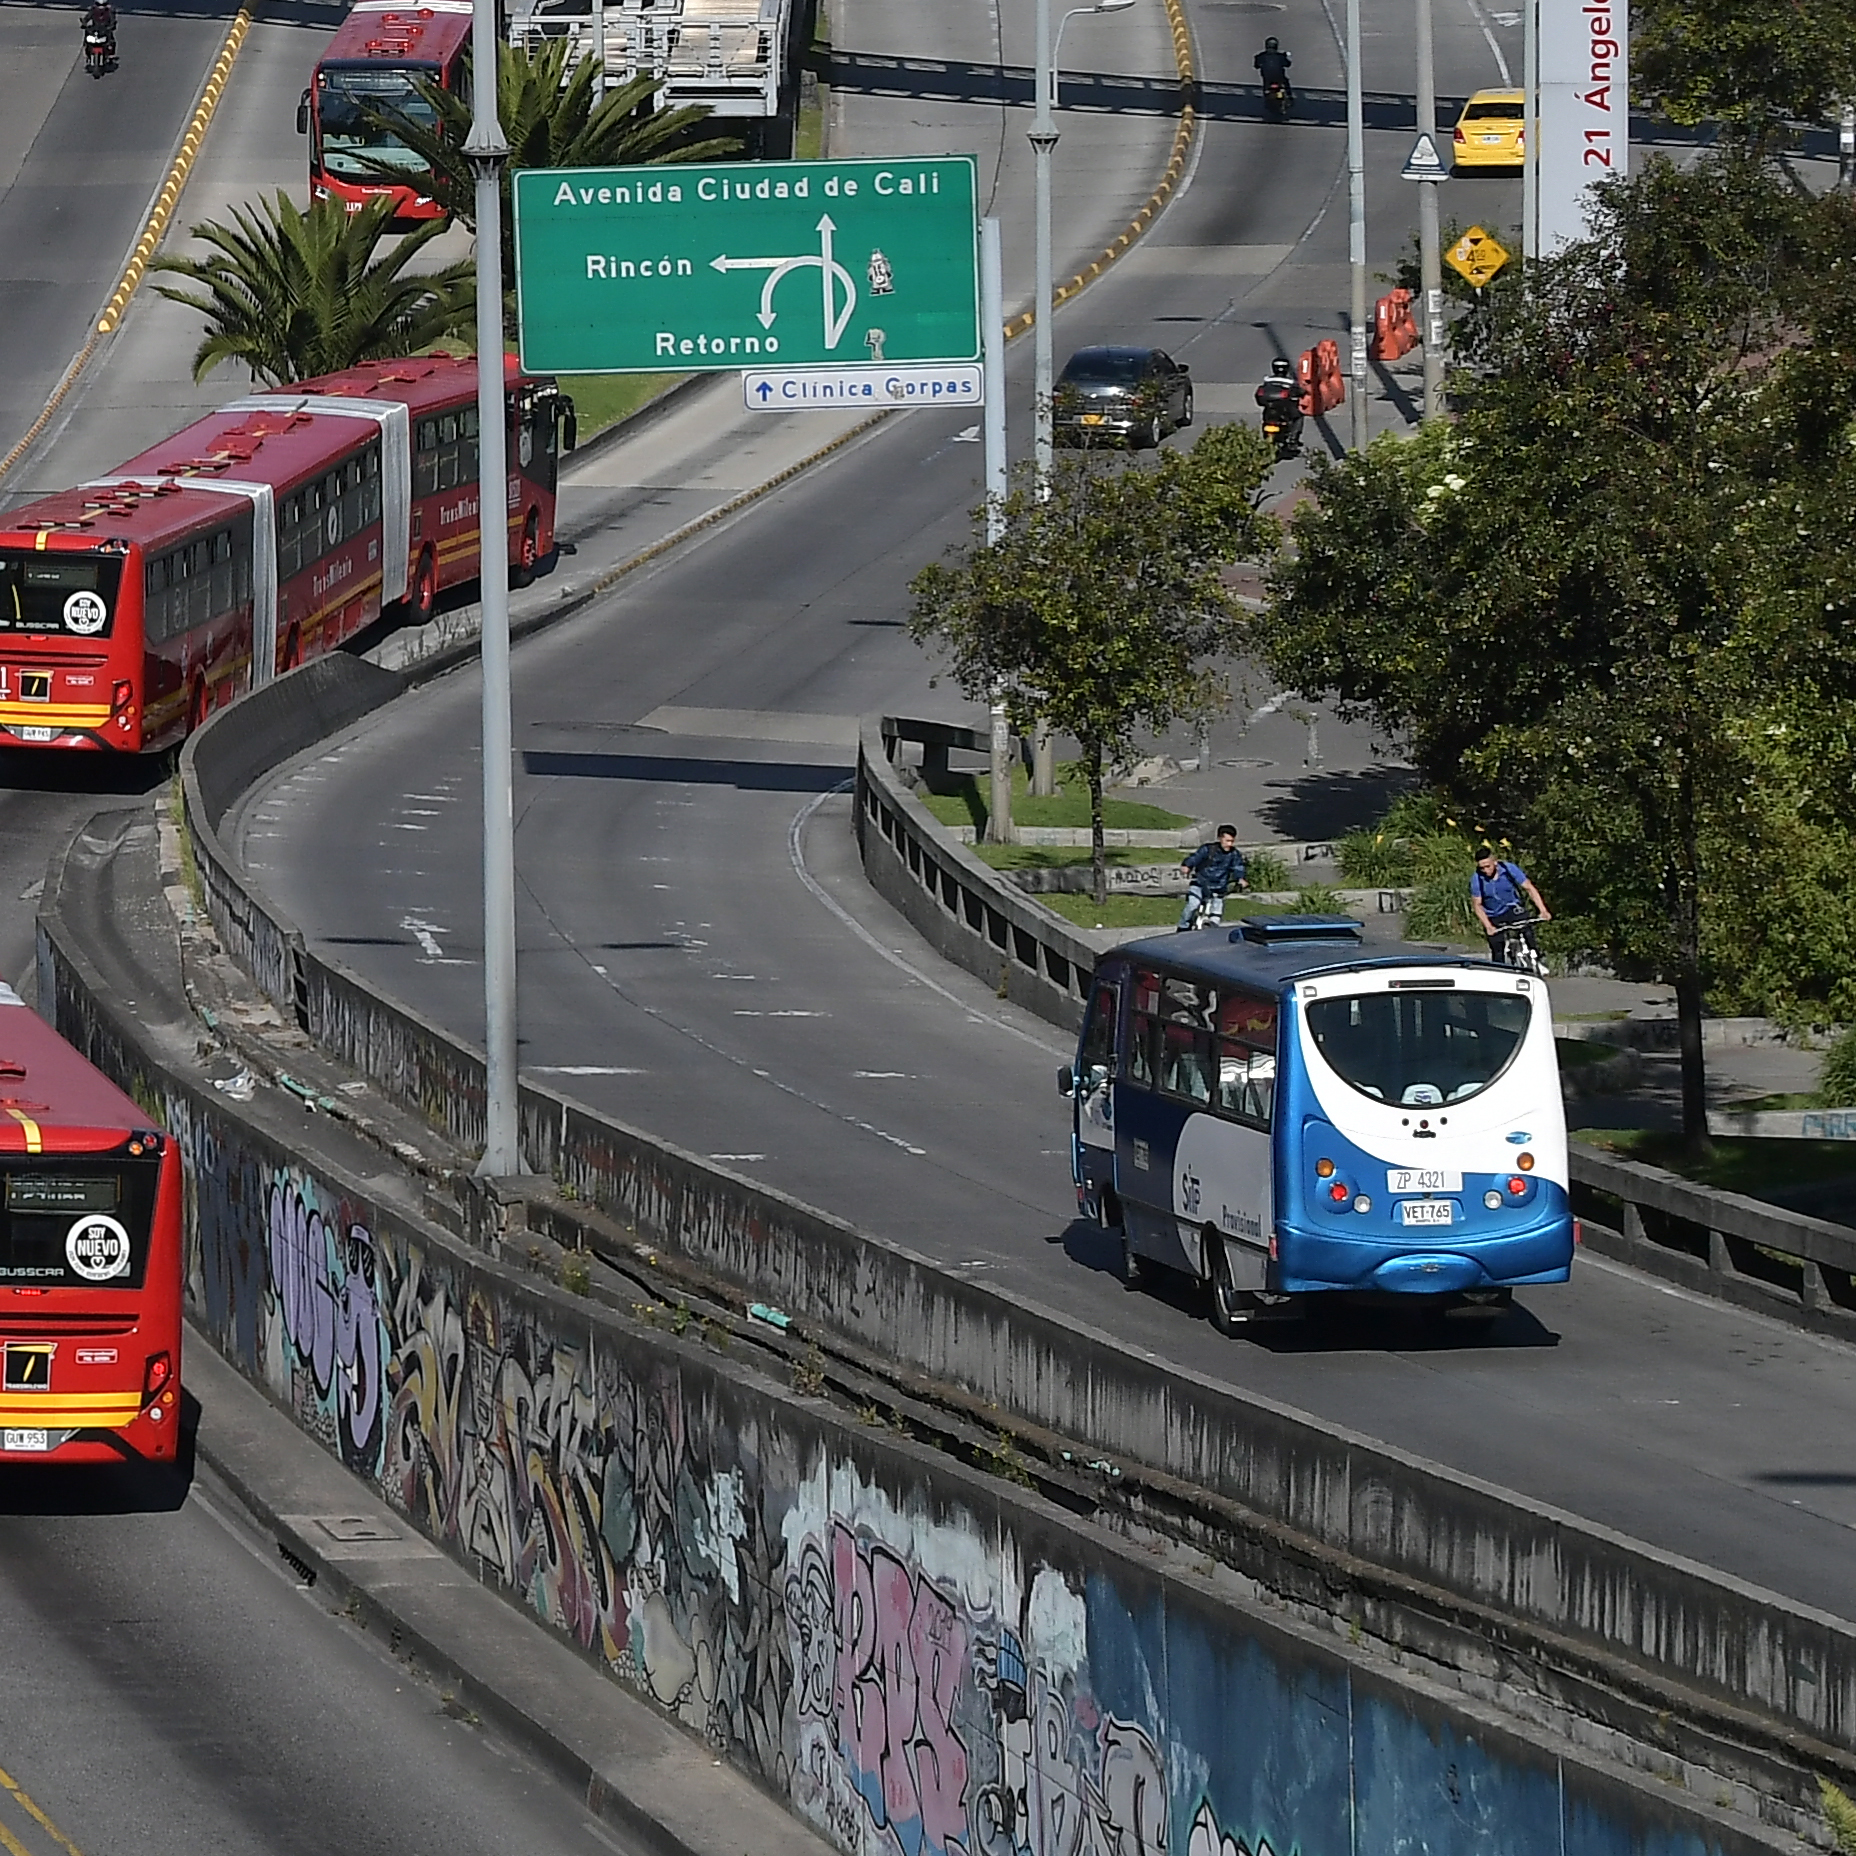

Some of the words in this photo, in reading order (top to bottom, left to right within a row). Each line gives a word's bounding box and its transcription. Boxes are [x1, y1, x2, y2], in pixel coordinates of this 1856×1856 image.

[1583, 130, 1611, 167] 21
[553, 180, 683, 206] Avenida
[697, 175, 810, 201] Ciudad
[824, 175, 859, 198] de
[874, 172, 941, 196] Cali
[586, 254, 693, 279] Rincón
[654, 331, 780, 357] Retorno
[782, 377, 873, 400] Clínica
[885, 375, 974, 401] Corpas
[1396, 1171, 1412, 1190] ZP
[1417, 1170, 1445, 1189] 4321
[88, 1226, 107, 1240] SOY
[1222, 1204, 1262, 1238] Provisional
[76, 1239, 119, 1257] NUEVO
